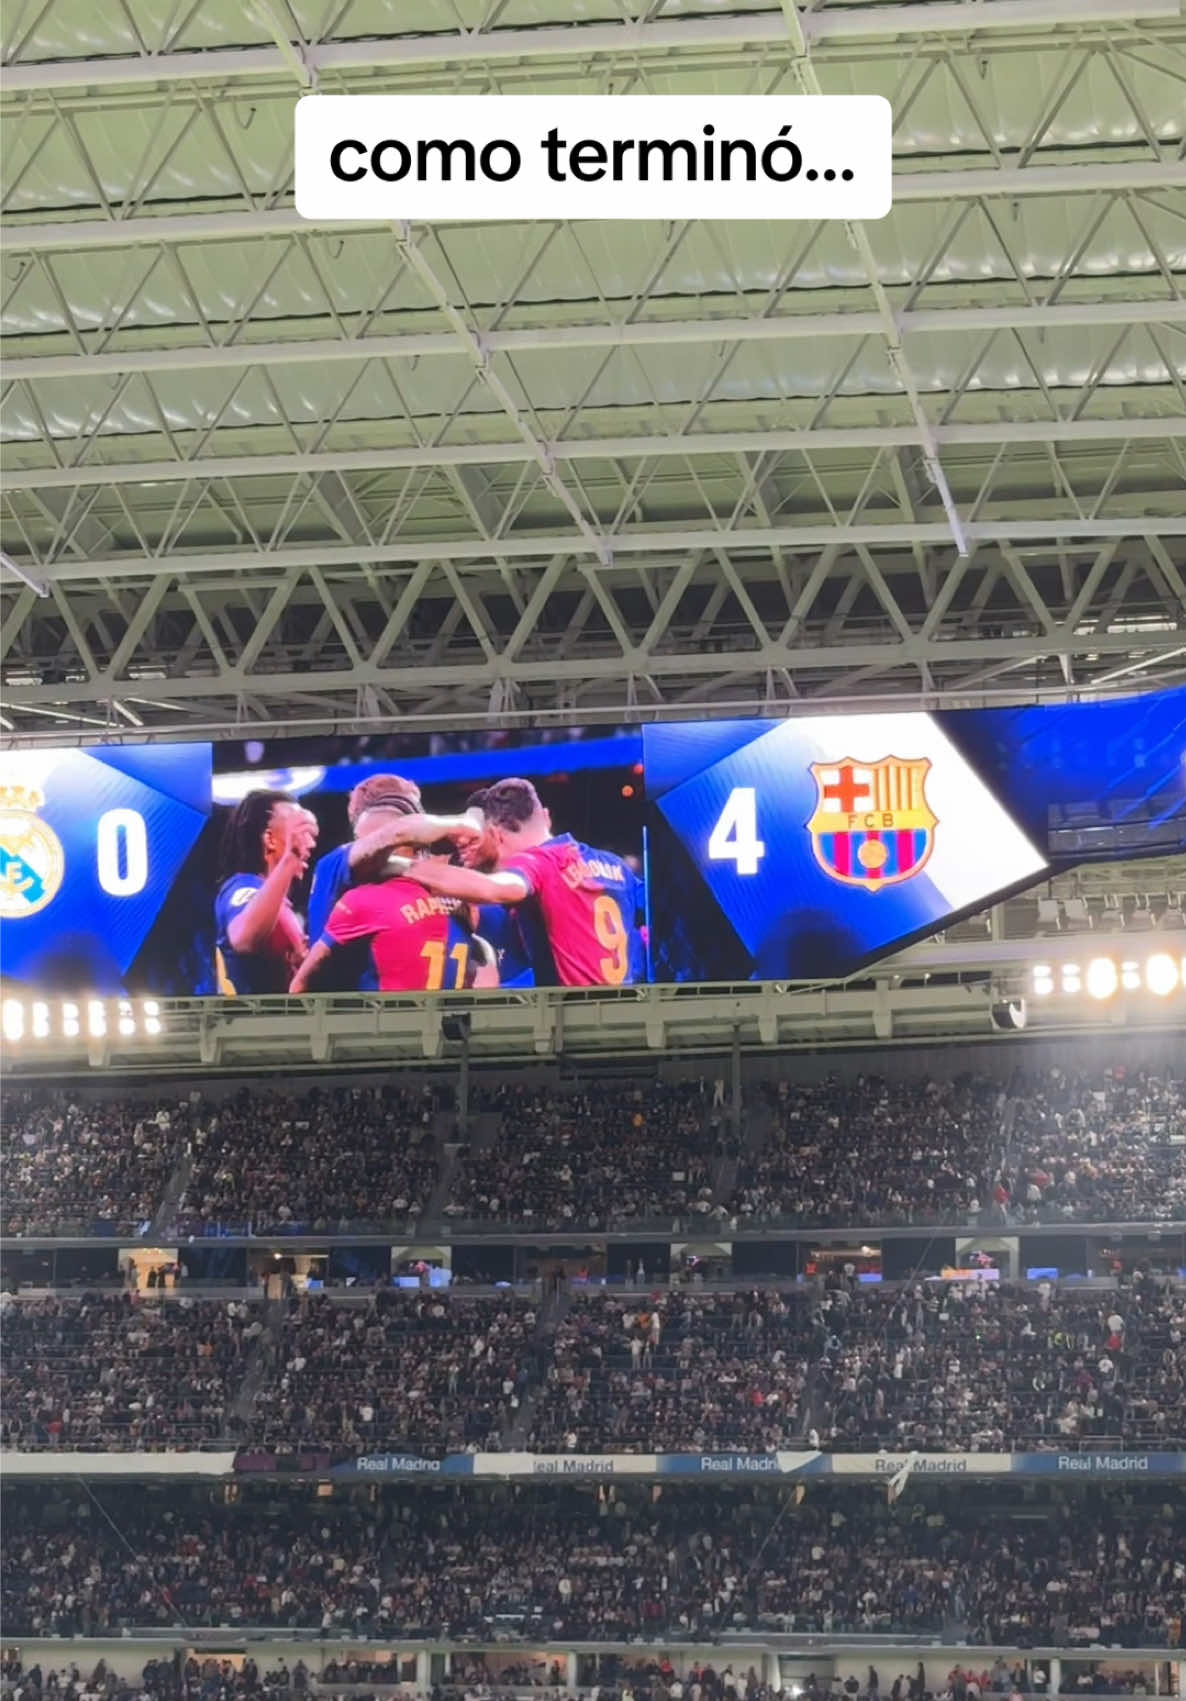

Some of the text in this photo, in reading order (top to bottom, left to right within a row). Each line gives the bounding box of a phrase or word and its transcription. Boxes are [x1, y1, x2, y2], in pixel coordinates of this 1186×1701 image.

[708, 787, 765, 876] 4
[97, 808, 148, 897] 0
[594, 895, 628, 986] 9
[420, 940, 469, 990] 11
[356, 1457, 388, 1471] Real
[533, 1459, 614, 1473] eal Madrid
[701, 1456, 733, 1471] Real
[912, 1459, 967, 1473] Madrid
[1058, 1455, 1149, 1470] Real Madrid
